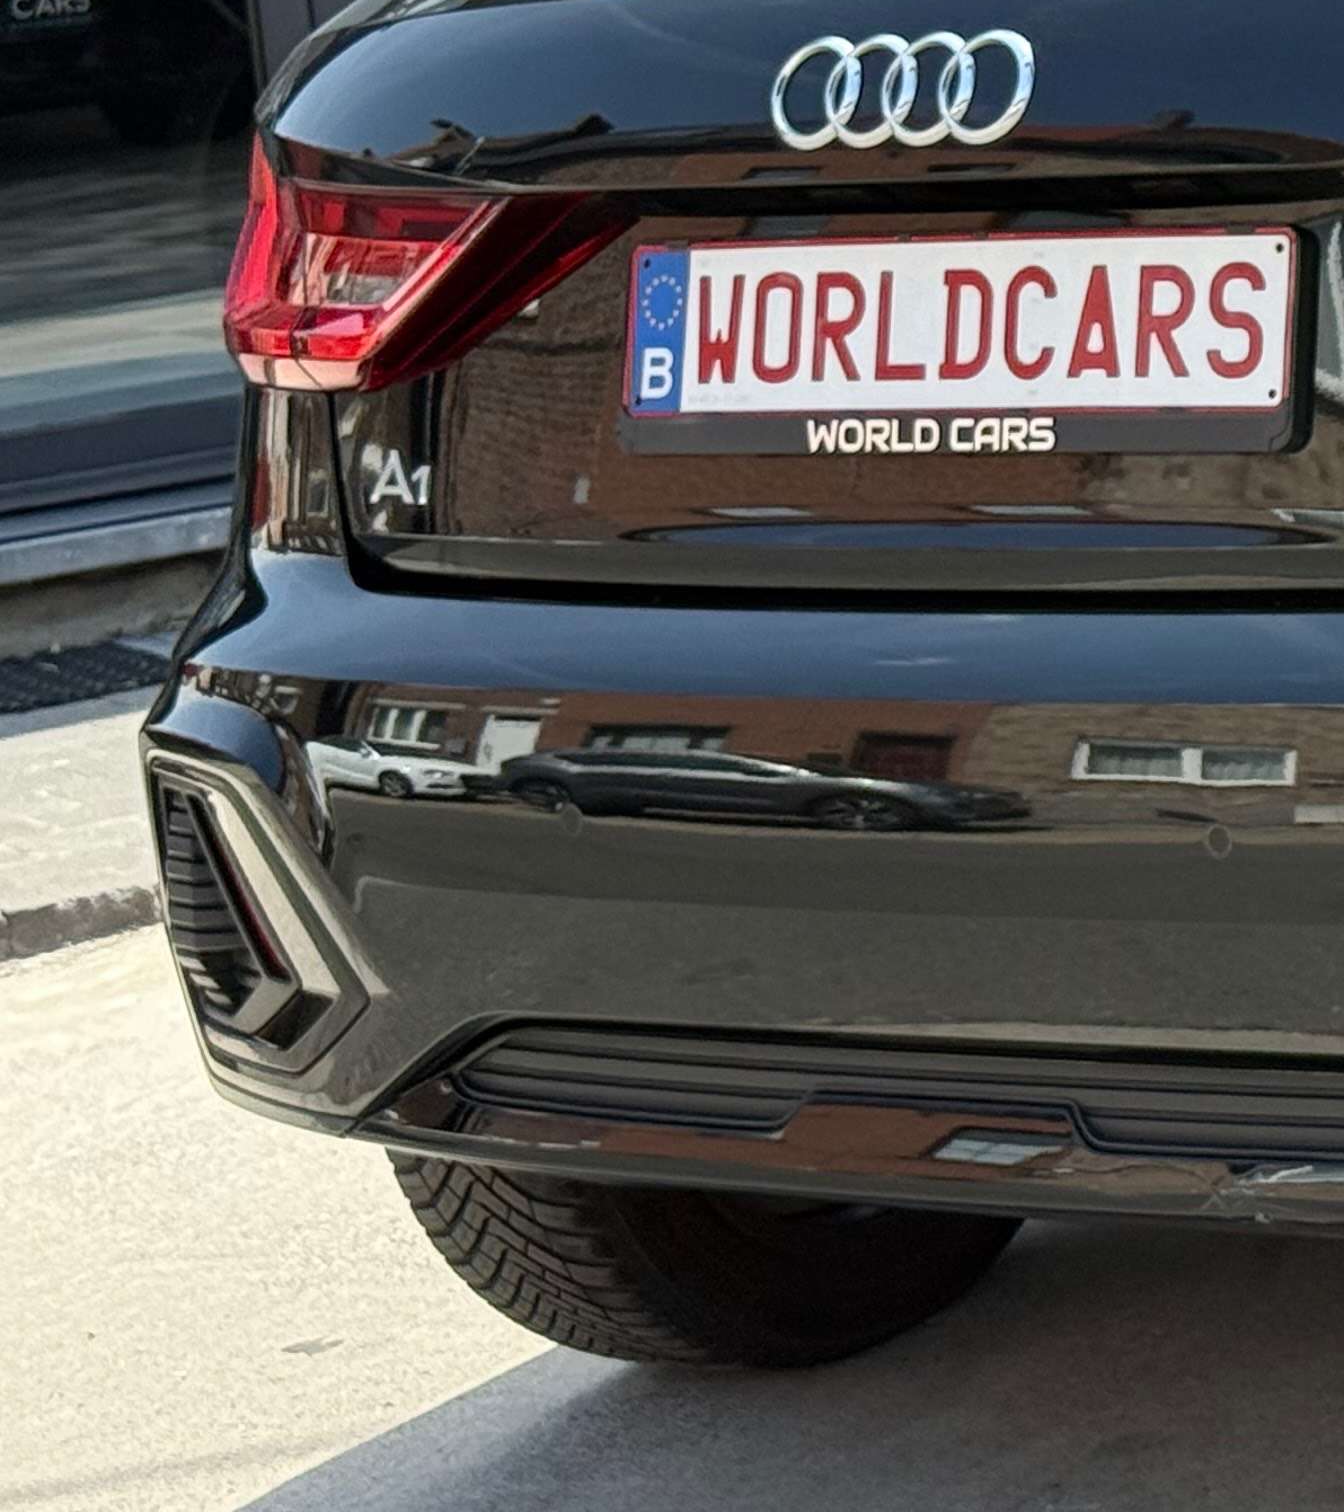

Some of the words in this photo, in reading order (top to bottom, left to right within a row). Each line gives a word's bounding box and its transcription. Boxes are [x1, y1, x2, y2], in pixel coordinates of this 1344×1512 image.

[641, 347, 674, 399] B
[697, 261, 1267, 385] WORLDCARS
[807, 418, 941, 454] WORLD
[949, 416, 1056, 453] CARS
[369, 448, 432, 506] A1
